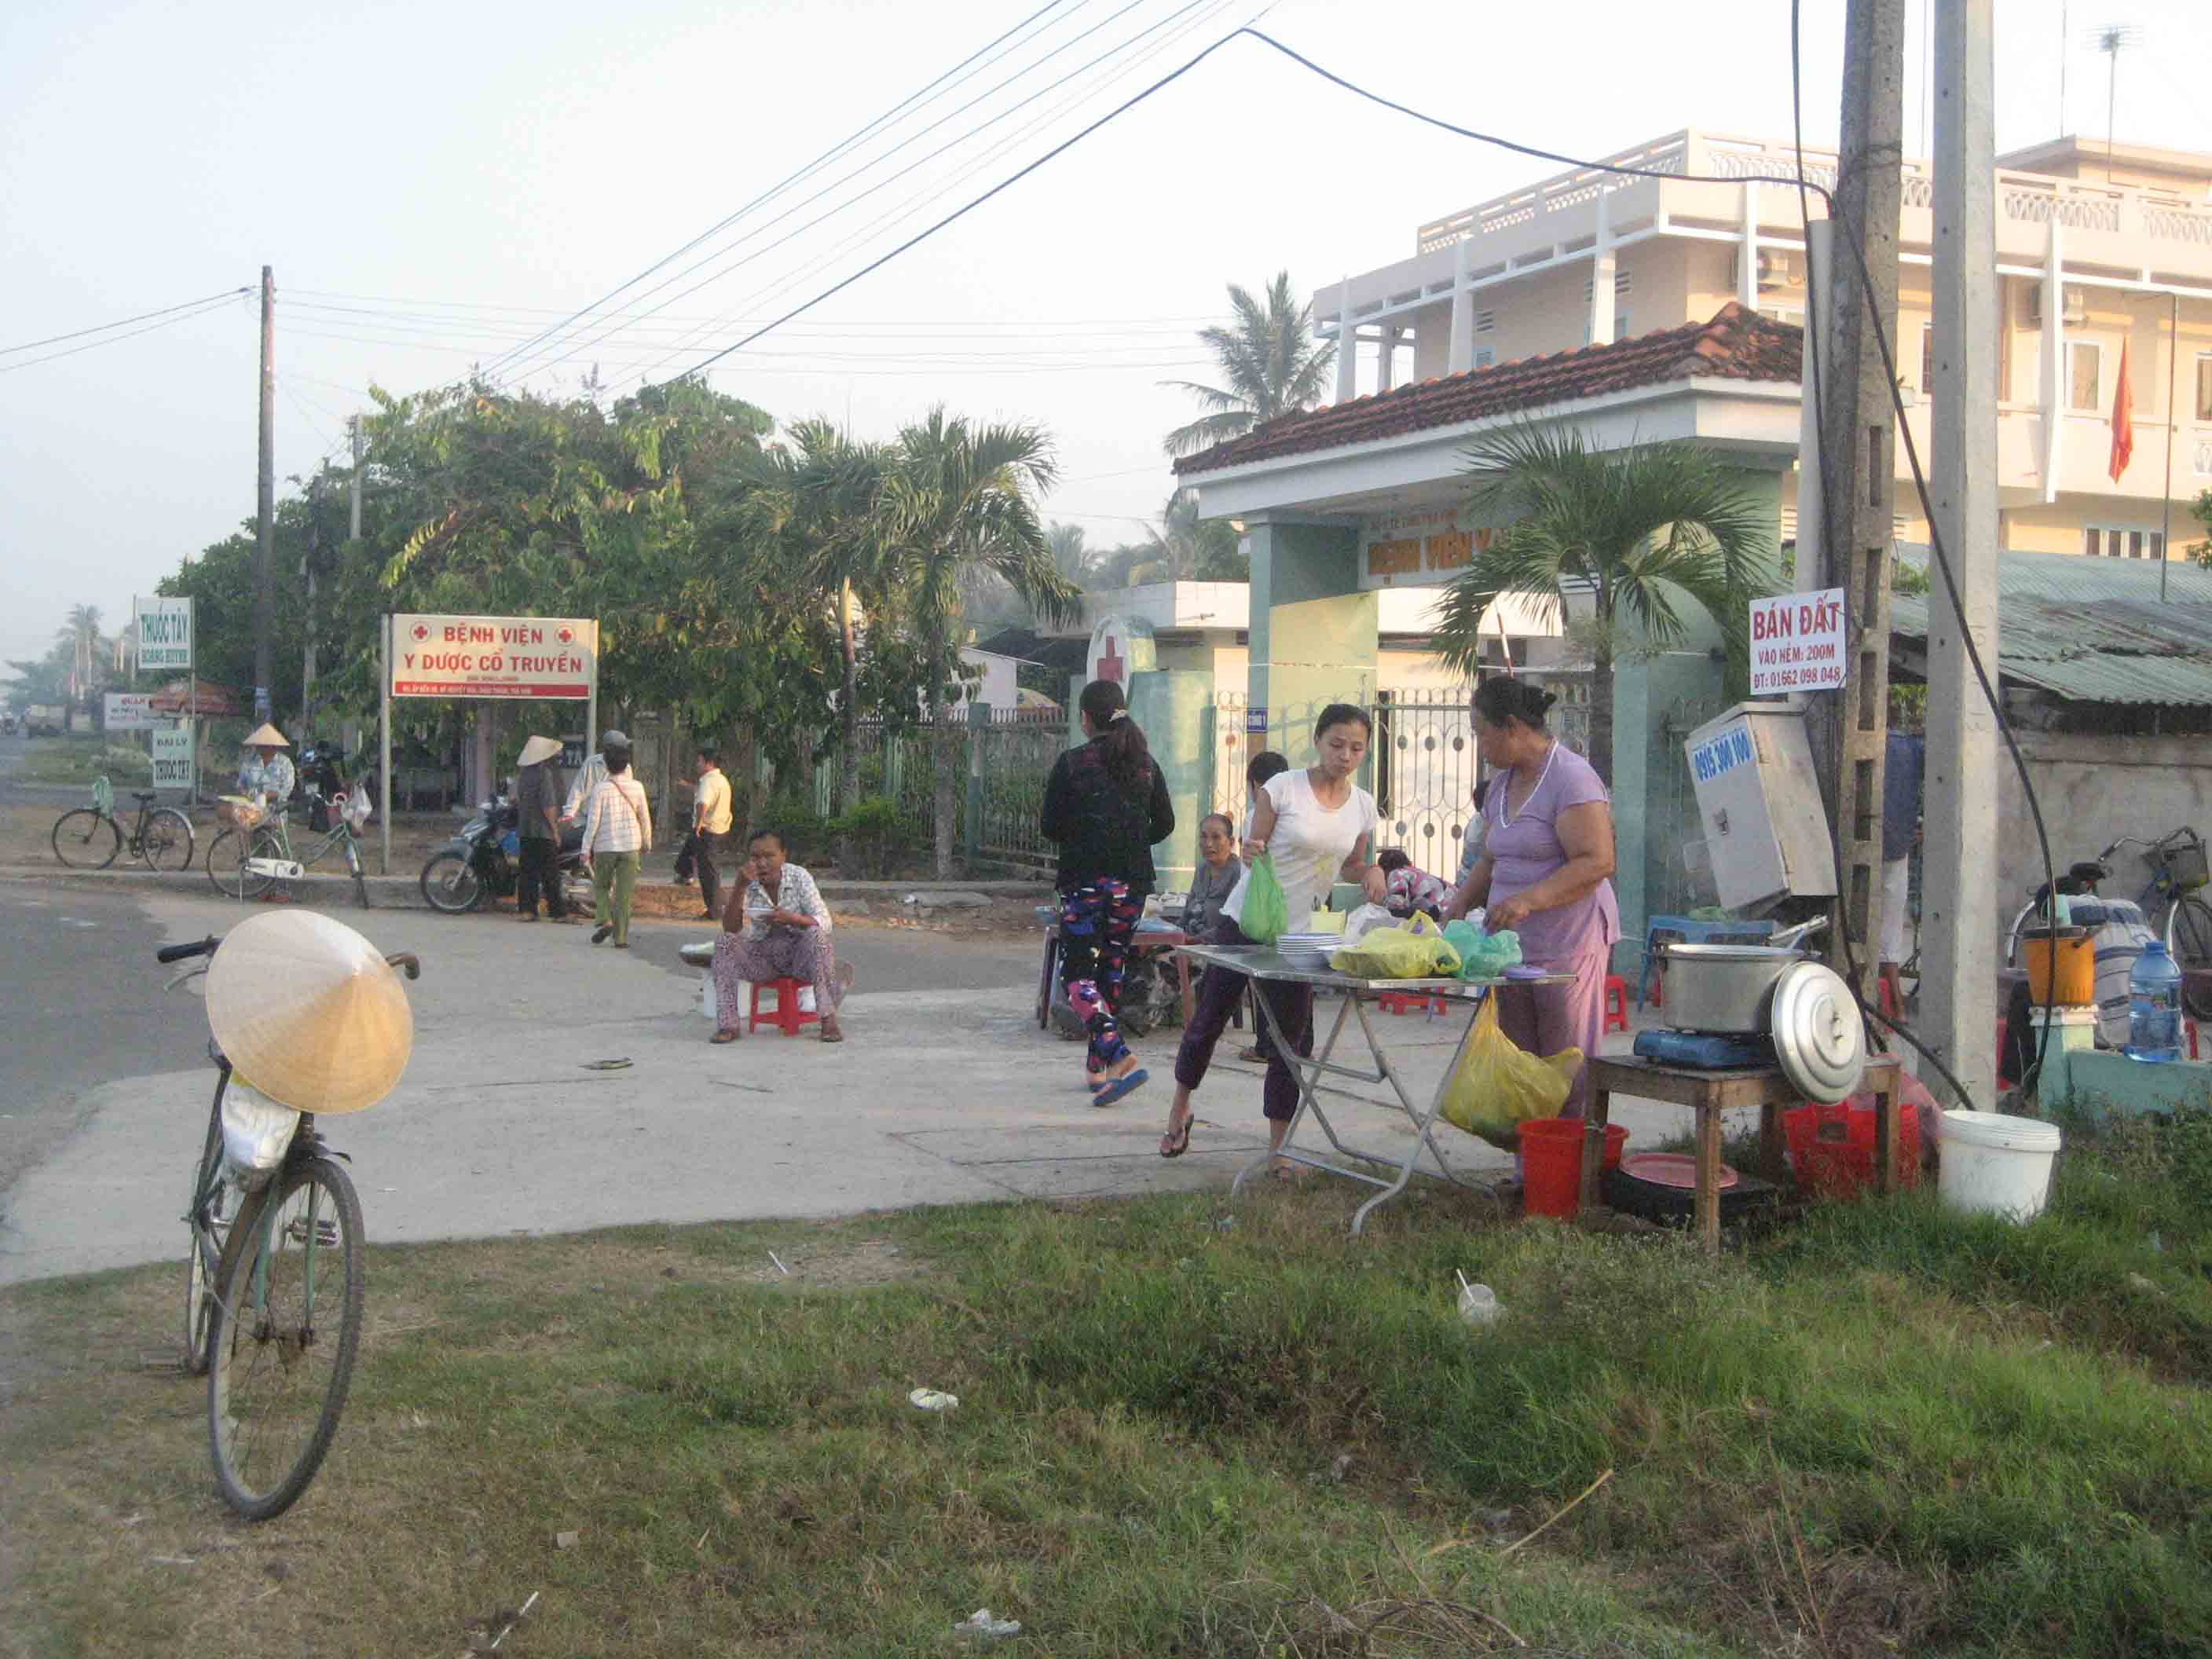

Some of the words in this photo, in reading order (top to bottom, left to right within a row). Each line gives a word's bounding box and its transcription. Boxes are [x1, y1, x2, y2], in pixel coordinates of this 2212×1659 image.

[1752, 602, 1792, 640] BÁN
[1799, 592, 1840, 635] ĐẤT
[444, 622, 494, 644] BỆNH
[501, 624, 543, 646] VIỆN
[404, 653, 415, 668] Y
[422, 651, 472, 673] DƯỢC
[1808, 643, 1835, 661] 200M
[1771, 670, 1797, 687] 01662
[1800, 667, 1818, 684] 098
[1821, 665, 1840, 683] 048
